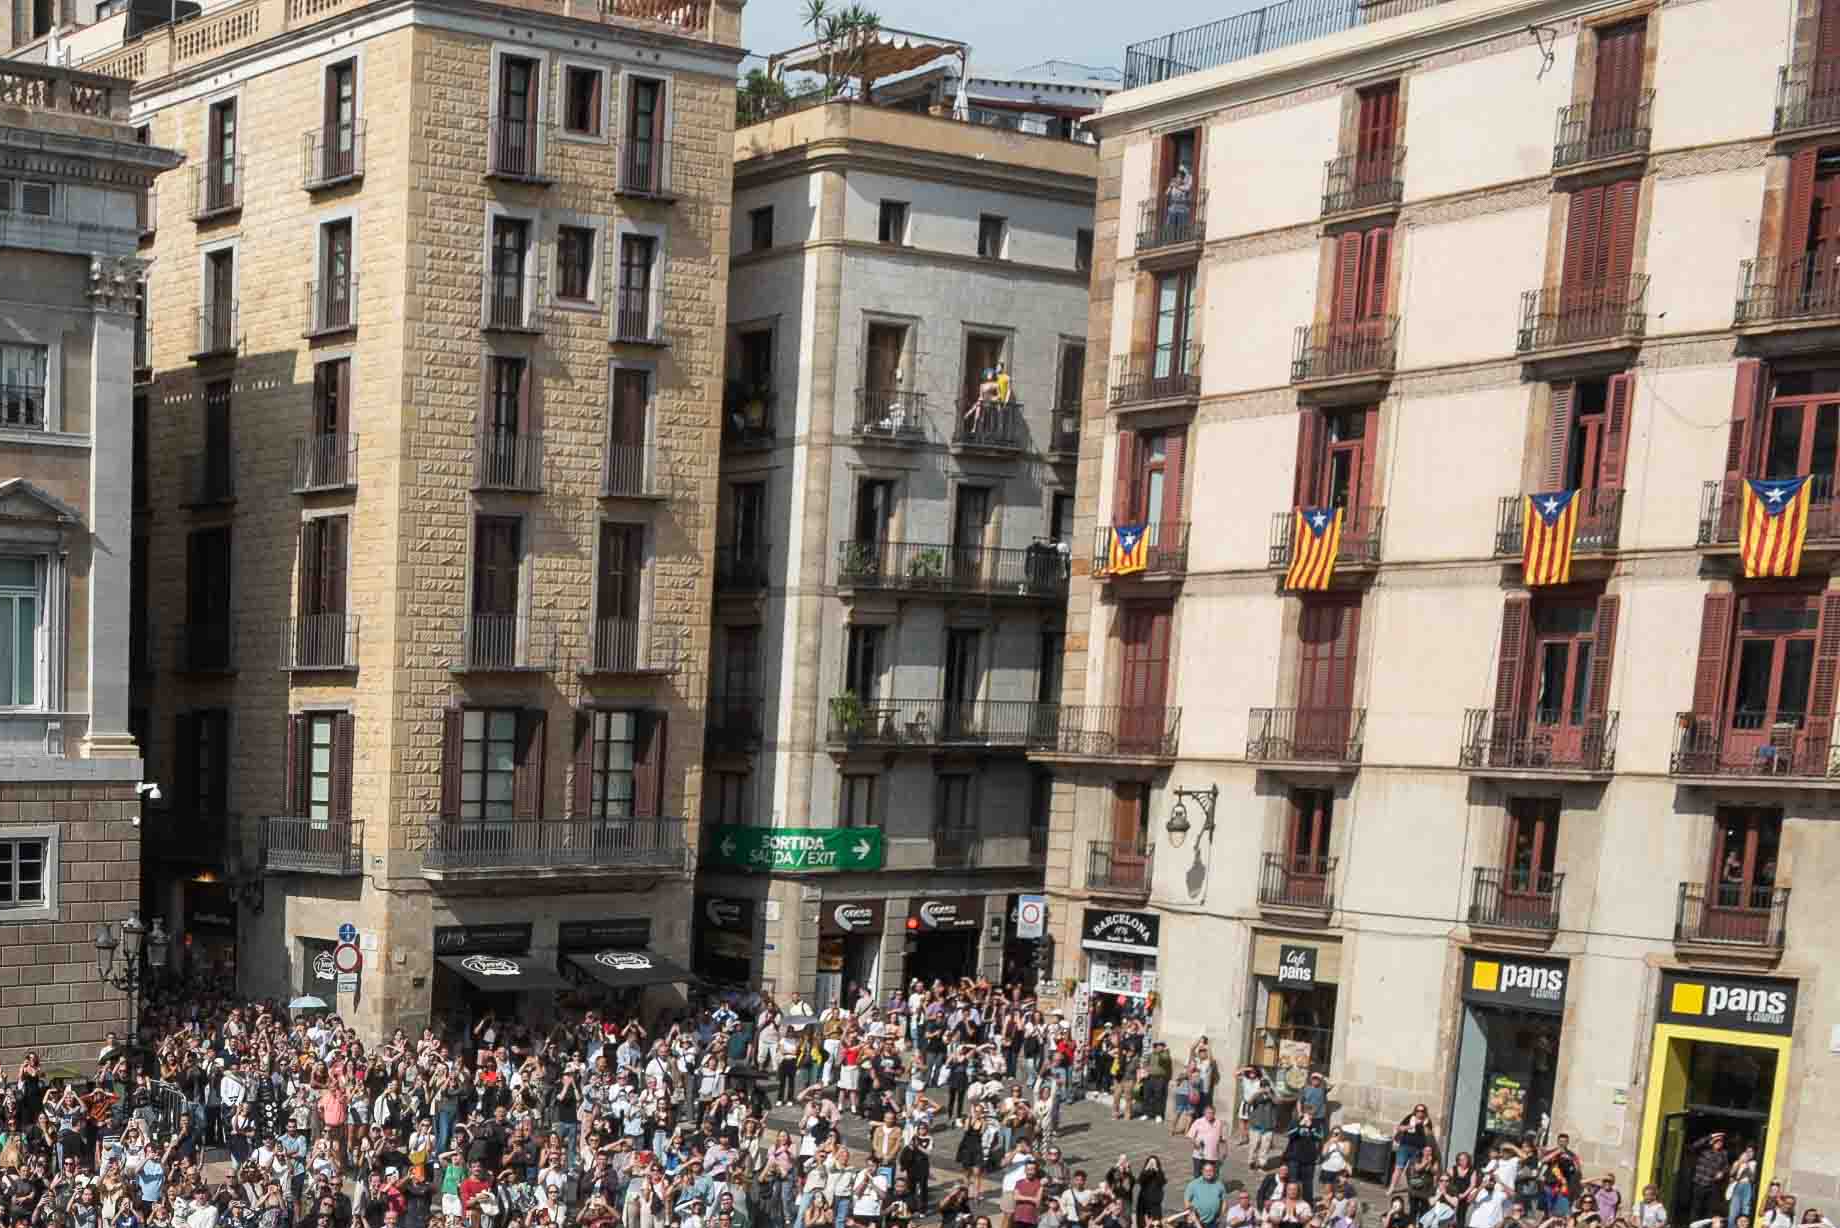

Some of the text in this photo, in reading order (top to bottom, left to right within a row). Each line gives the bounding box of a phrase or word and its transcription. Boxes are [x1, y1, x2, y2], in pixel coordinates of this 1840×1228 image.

[762, 835, 825, 850] SORTIDA
[749, 849, 793, 866] SALIDA
[807, 850, 837, 866] EXIT
[1092, 913, 1151, 942] BARCELONA
[1278, 965, 1312, 983] pans
[1501, 963, 1564, 993] pans
[1707, 984, 1787, 1016] pans
